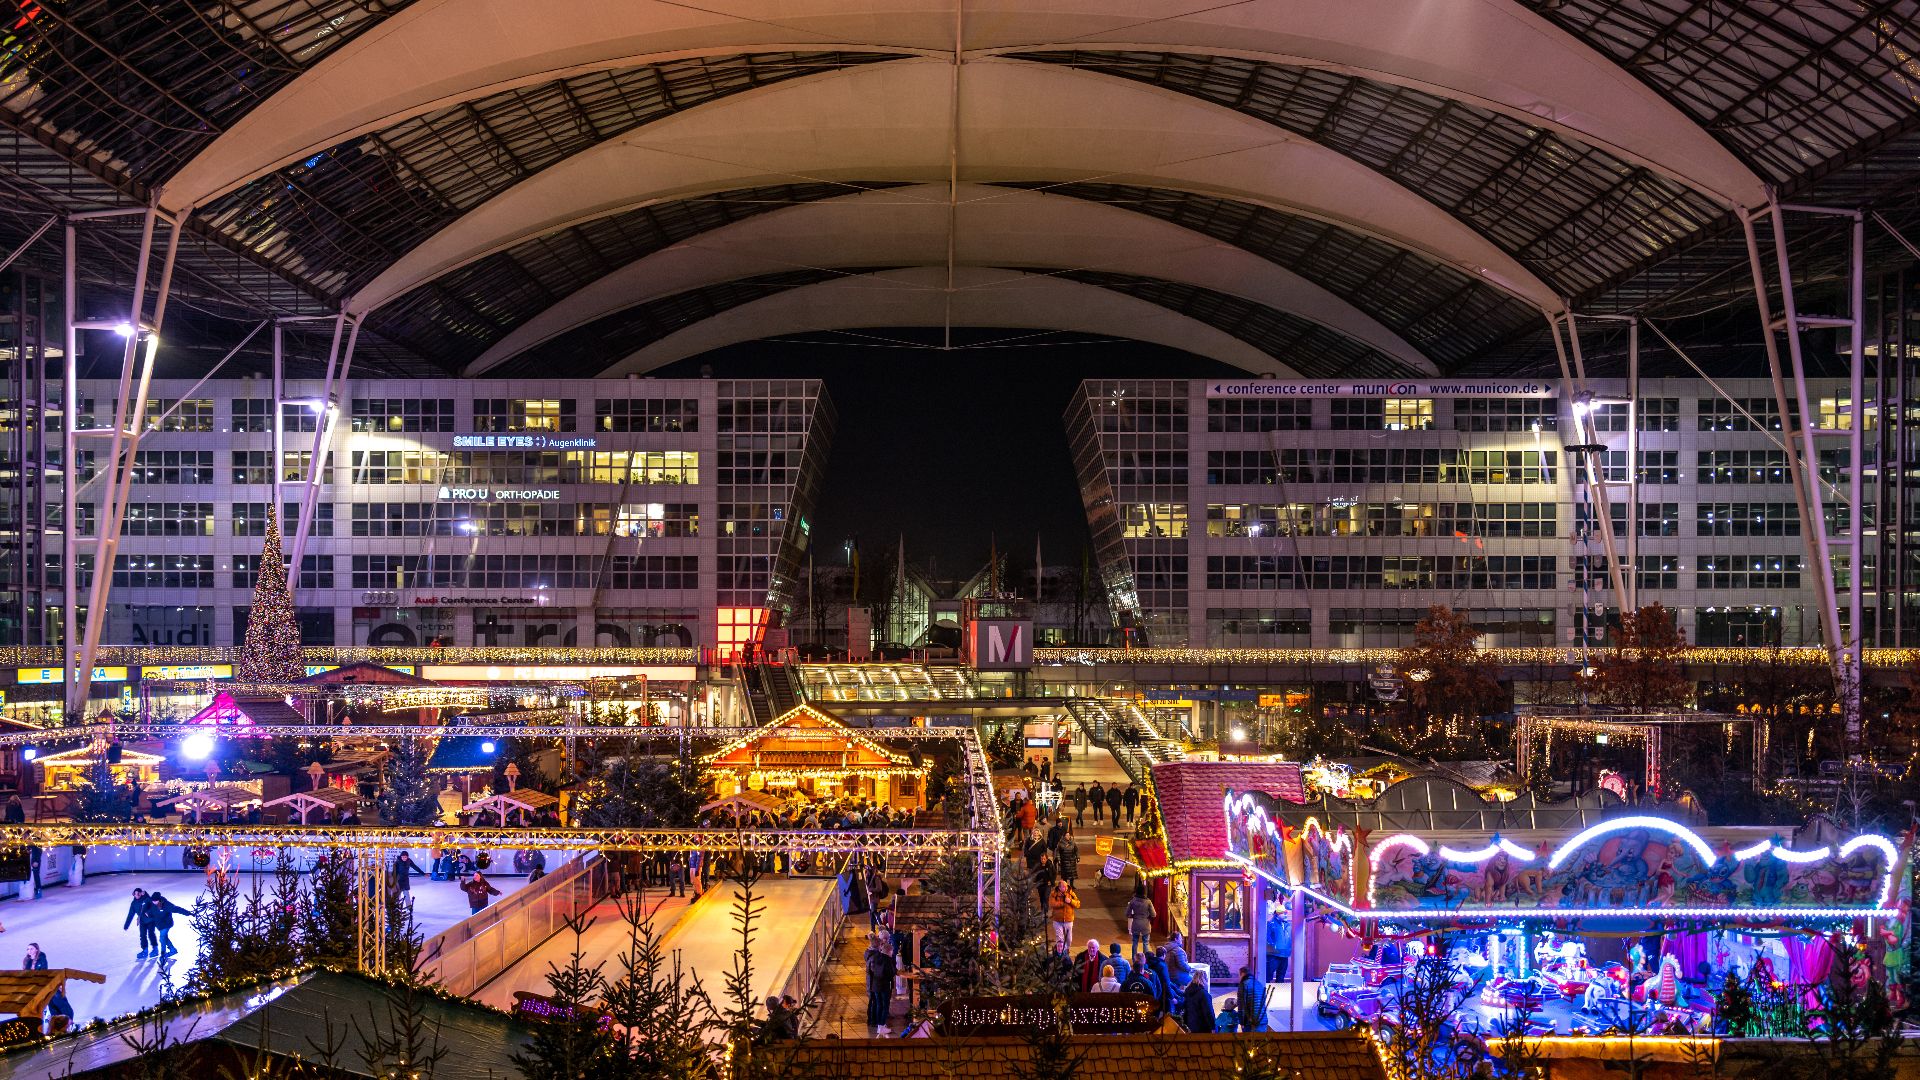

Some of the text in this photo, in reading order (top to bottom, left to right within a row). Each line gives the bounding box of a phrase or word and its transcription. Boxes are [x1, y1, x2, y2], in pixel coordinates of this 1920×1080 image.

[1226, 382, 1340, 395] conference center
[1430, 382, 1539, 394] www.municon.de
[453, 435, 495, 447] SMILE
[497, 435, 534, 447] EYES
[549, 438, 596, 448] Augenklinik
[453, 489, 476, 499] PRO
[495, 489, 560, 499] ORTHOPÄDIE
[415, 597, 535, 605] Audi Conference Center
[416, 623, 454, 631] e-tron
[133, 623, 209, 646] Audi
[989, 624, 1022, 663] M
